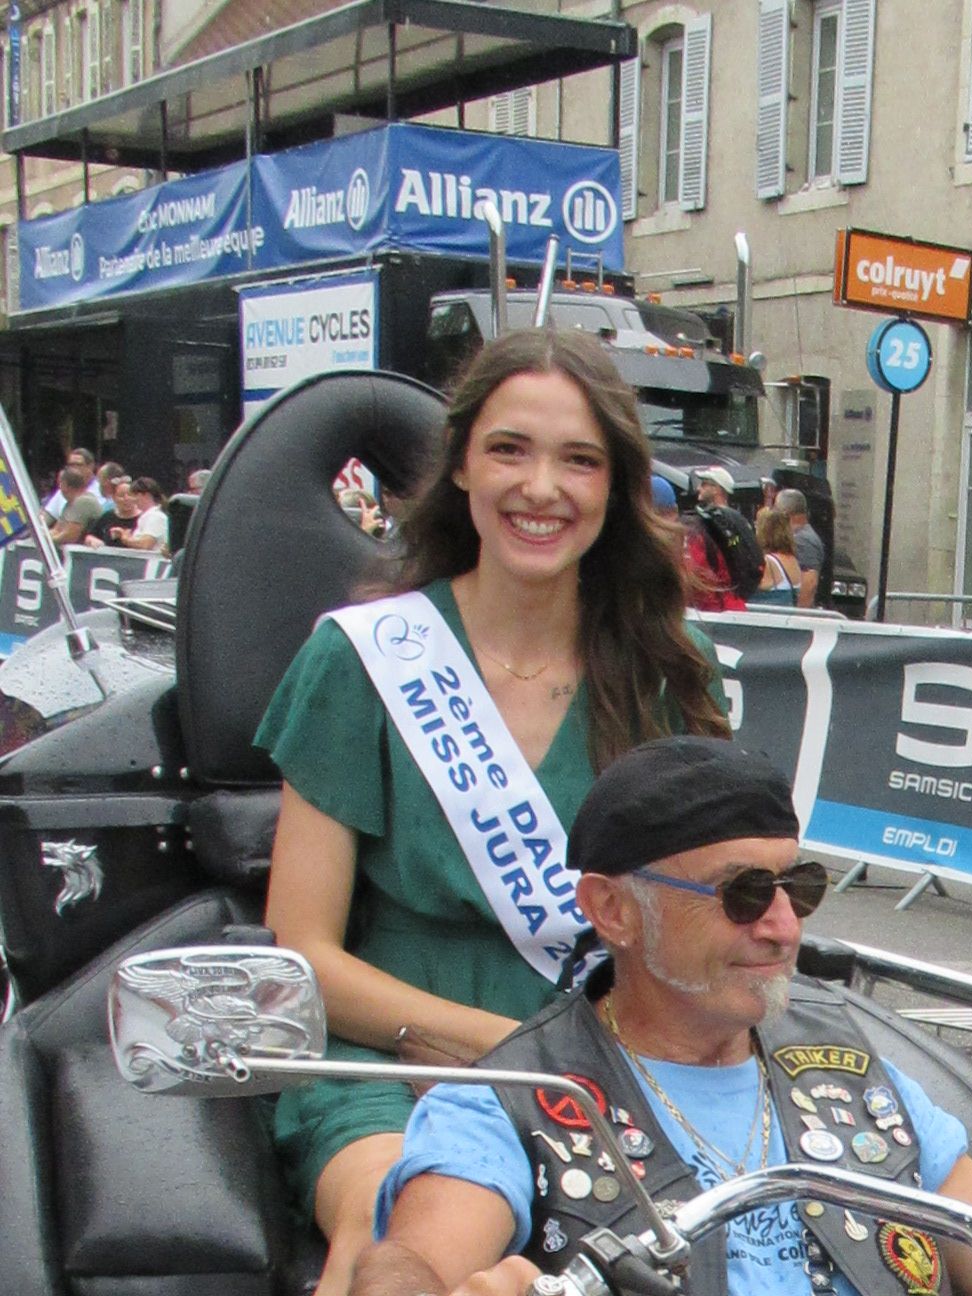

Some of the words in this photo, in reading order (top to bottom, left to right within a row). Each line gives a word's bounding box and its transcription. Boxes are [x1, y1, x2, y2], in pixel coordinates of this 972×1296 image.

[283, 186, 345, 231] Allianz
[394, 168, 553, 227] Allianz
[34, 246, 70, 280] Allianz
[146, 246, 160, 269] de
[162, 241, 173, 265] la
[856, 255, 946, 301] colruyt
[246, 316, 304, 350] AVENUE
[309, 308, 370, 344] CYCLES
[885, 338, 922, 370] 25
[399, 678, 478, 793] MISS
[470, 808, 548, 937] JURA
[431, 664, 509, 790] 2ème
[508, 800, 588, 926] DAUP
[882, 826, 956, 857] EMPLOI
[783, 1049, 857, 1069] TRIKER
